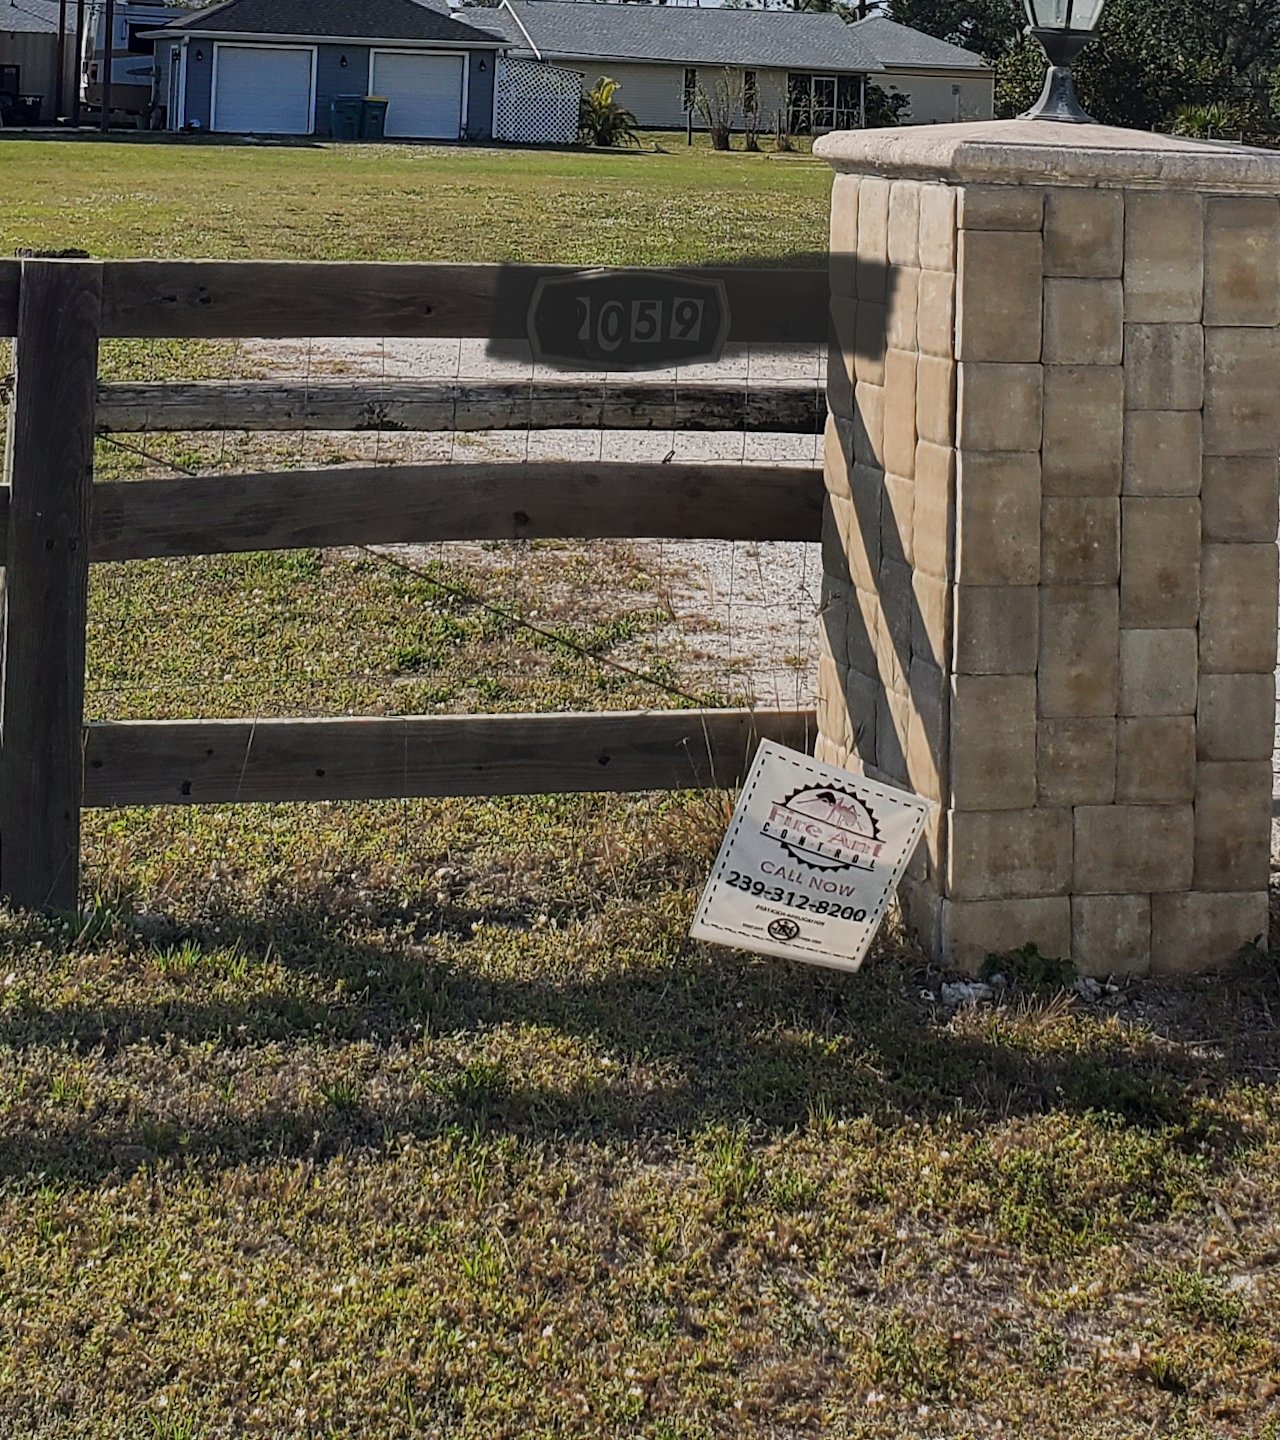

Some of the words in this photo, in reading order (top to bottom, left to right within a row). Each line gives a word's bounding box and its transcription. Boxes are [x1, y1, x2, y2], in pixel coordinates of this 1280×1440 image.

[769, 804, 823, 838] Fire
[725, 870, 867, 923] 239-312-8200
[760, 860, 803, 885] CALL
[808, 874, 856, 898] NOW
